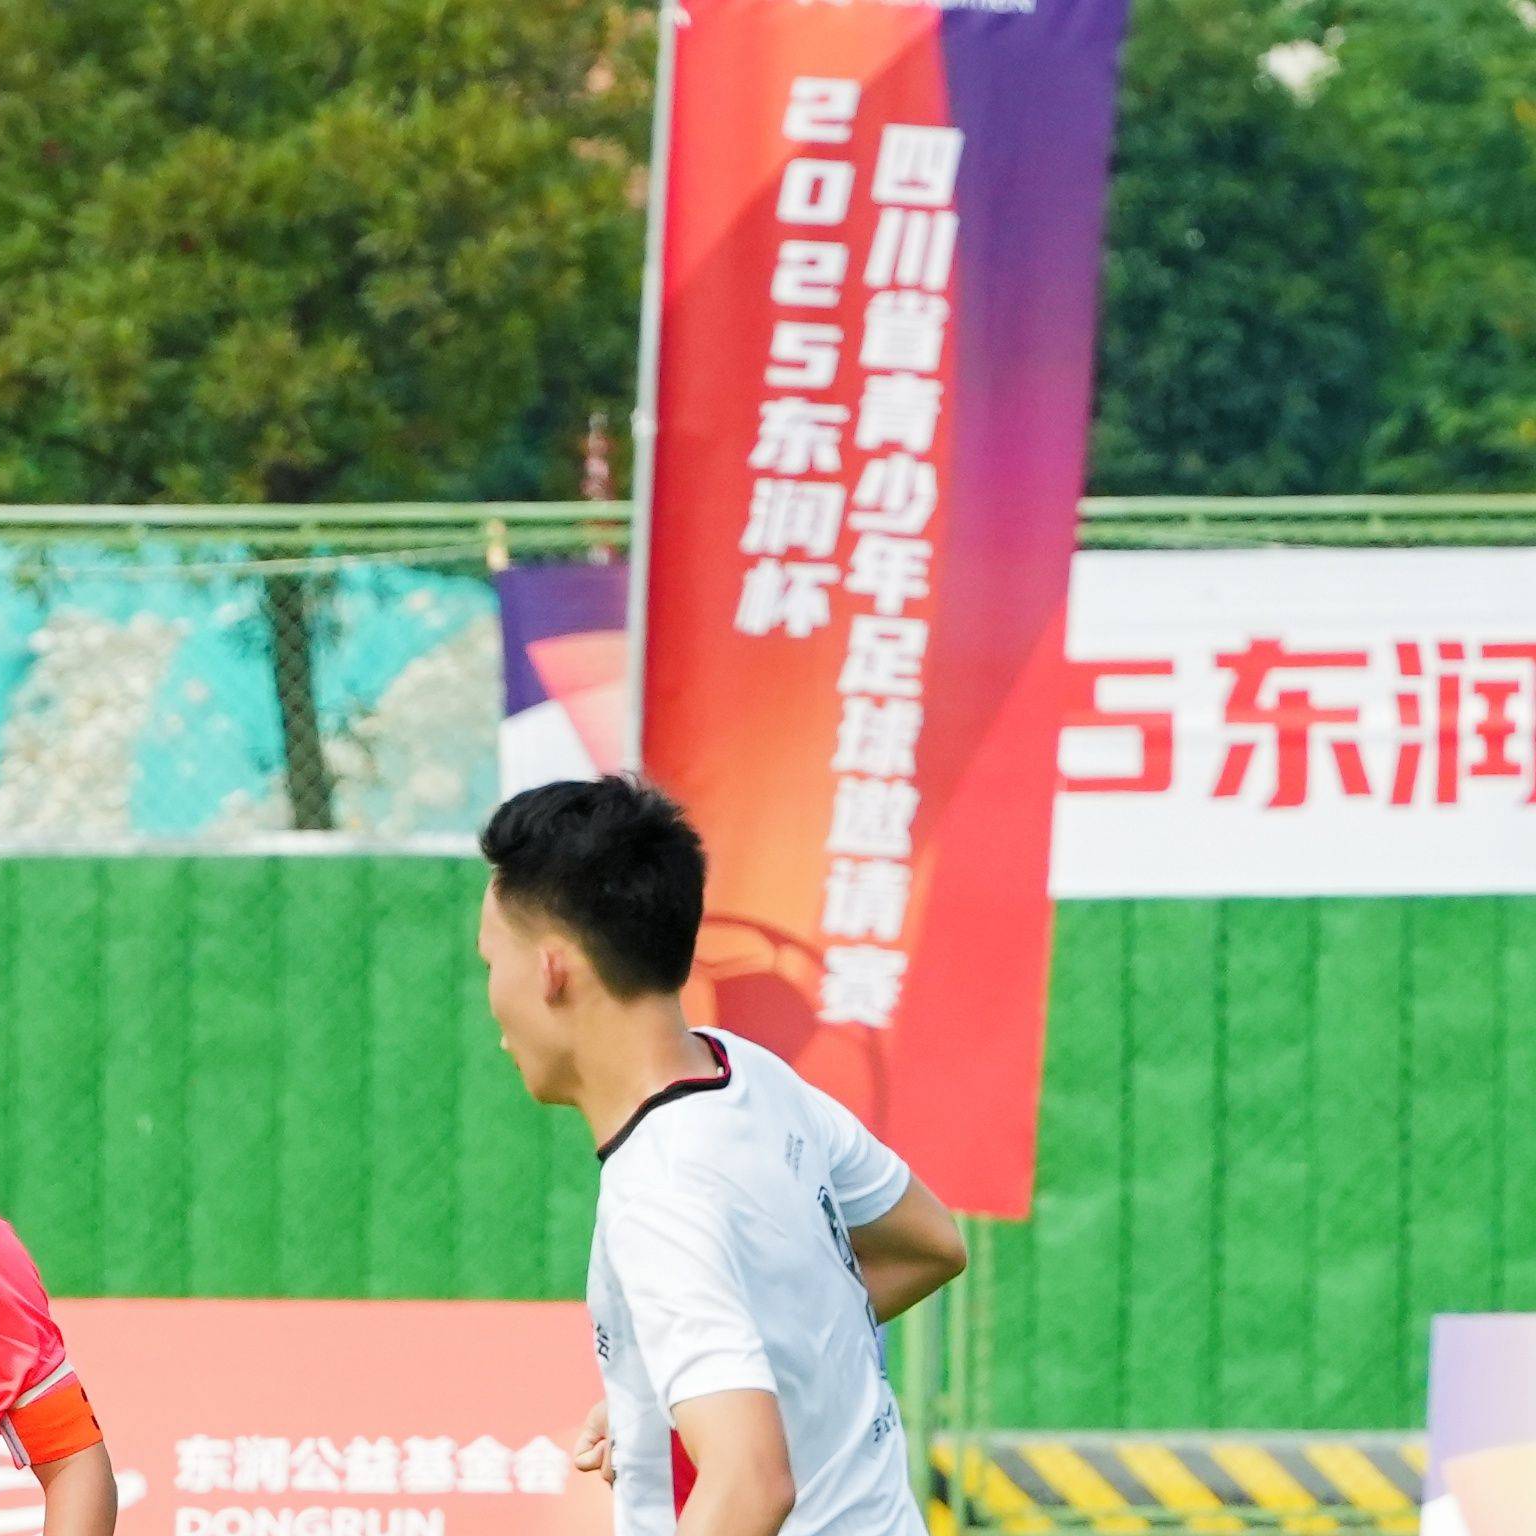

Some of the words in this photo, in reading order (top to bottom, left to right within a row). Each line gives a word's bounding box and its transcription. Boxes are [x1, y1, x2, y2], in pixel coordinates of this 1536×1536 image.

[734, 76, 863, 637] 2025东润杯
[817, 123, 965, 1028] 四川省青少年足球邀请赛
[174, 1434, 568, 1494] 东润公益基金会
